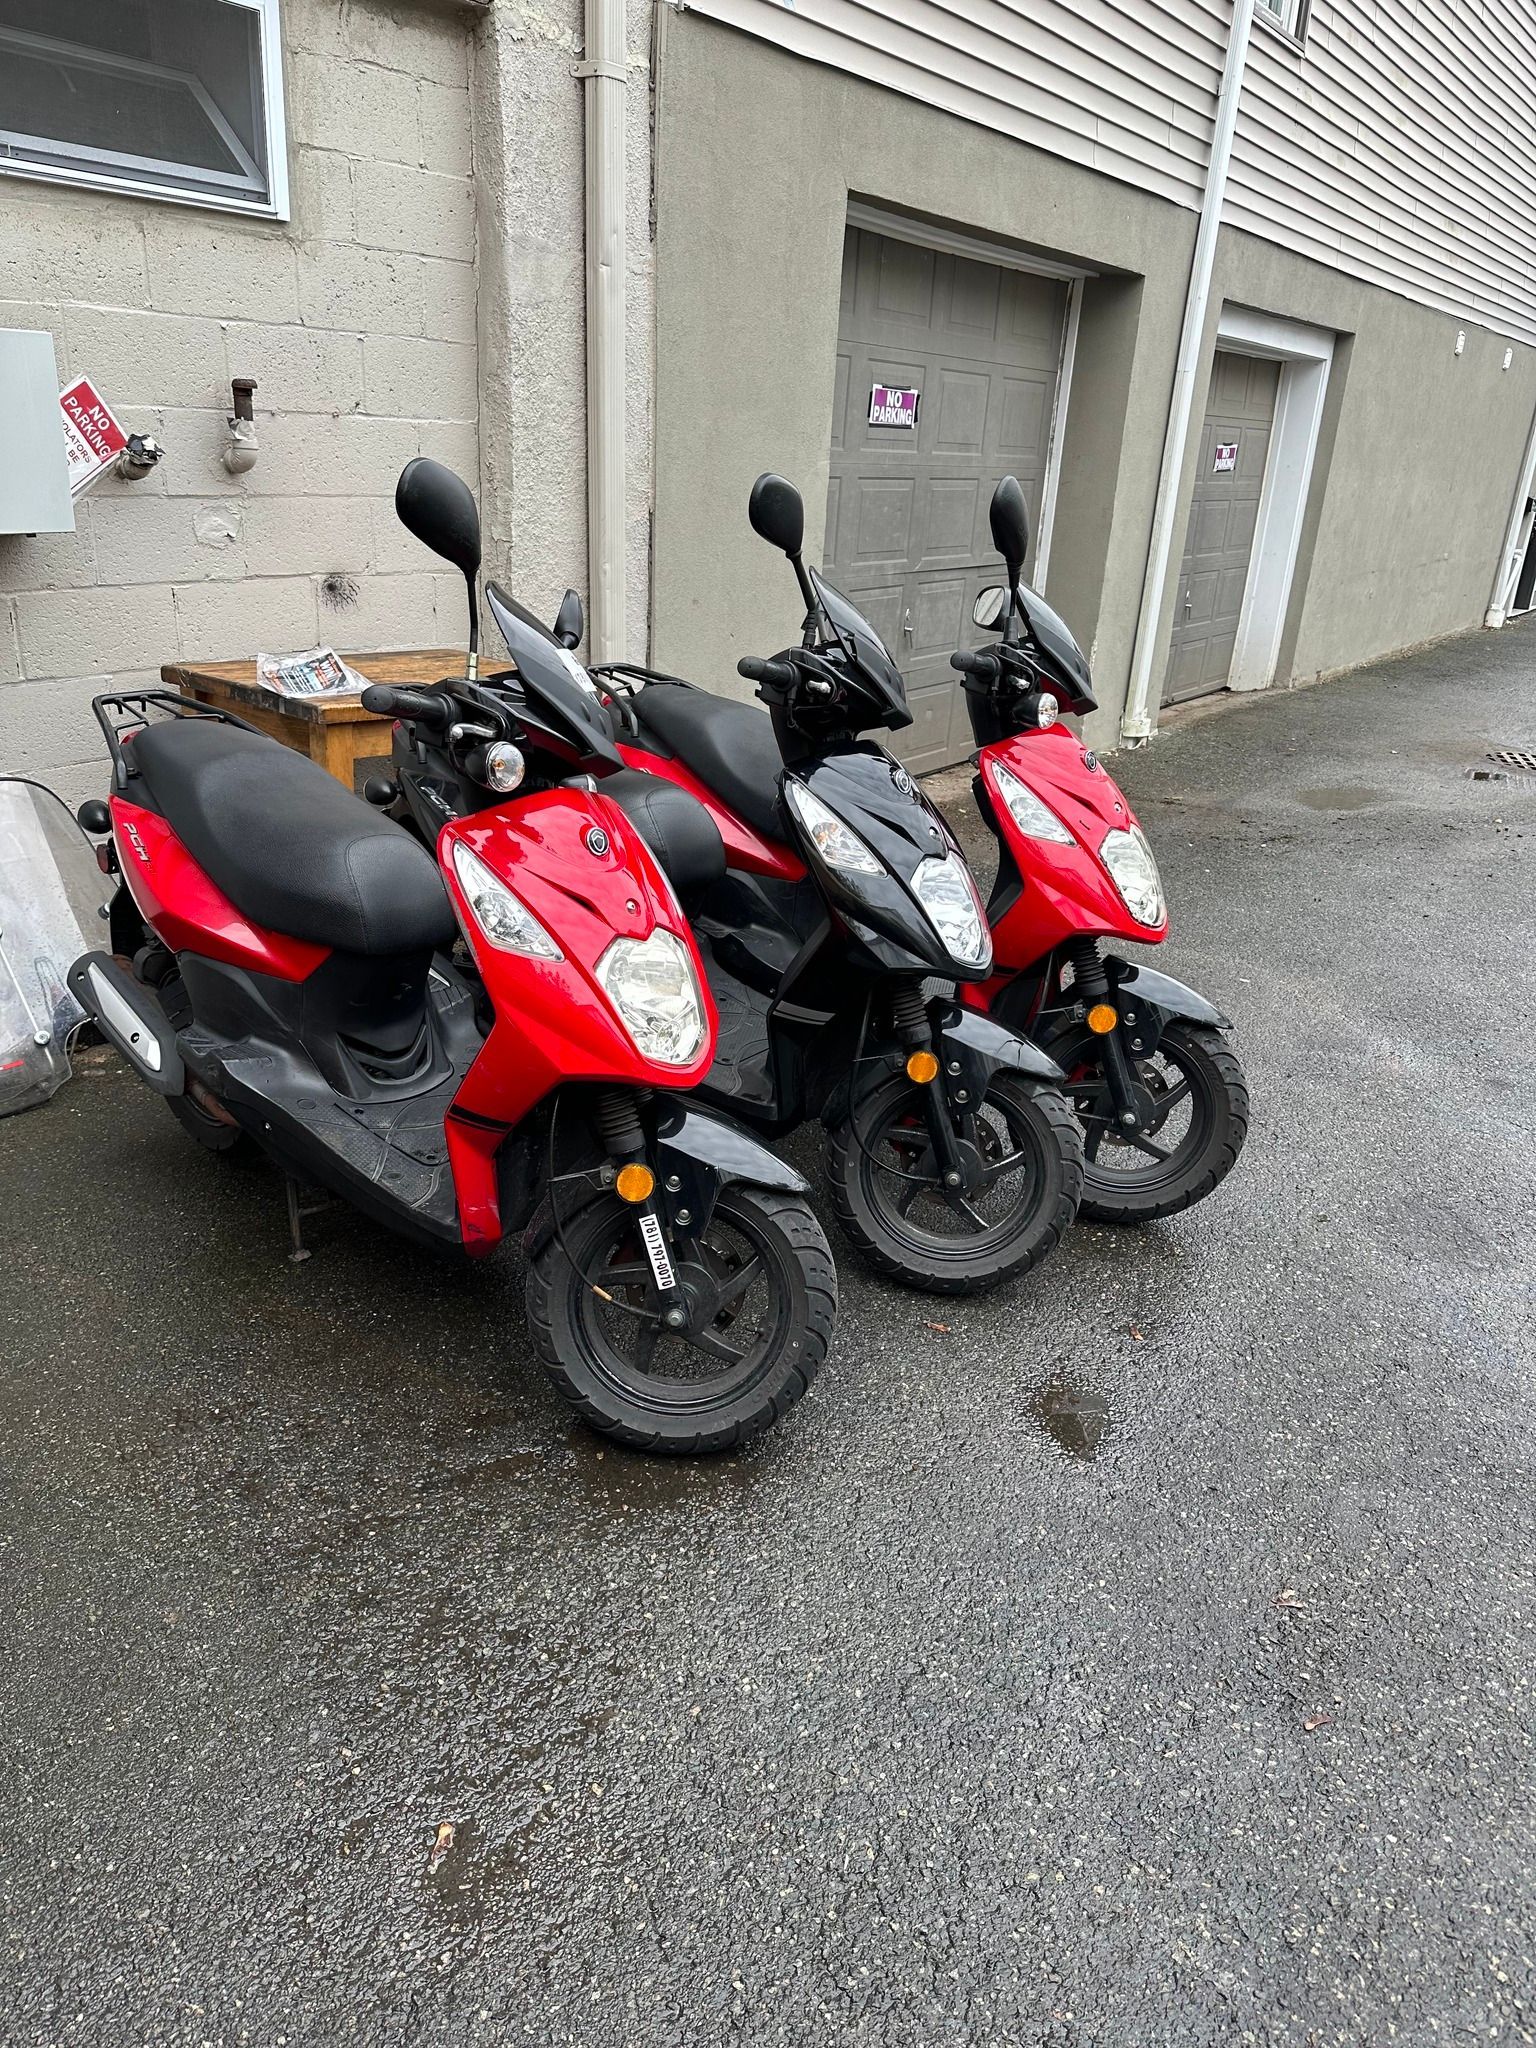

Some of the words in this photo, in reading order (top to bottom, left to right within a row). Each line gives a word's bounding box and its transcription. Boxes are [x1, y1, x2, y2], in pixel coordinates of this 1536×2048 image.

[886, 390, 903, 408] NO
[64, 396, 112, 459] PARKING
[88, 405, 110, 431] NO
[873, 405, 913, 425] PARKING
[62, 419, 93, 465] OLATORS
[68, 450, 81, 464] BE
[420, 786, 458, 816] PCH
[122, 822, 151, 862] PCH
[641, 1217, 660, 1243] (781)
[651, 1243, 673, 1287] 797-0070
